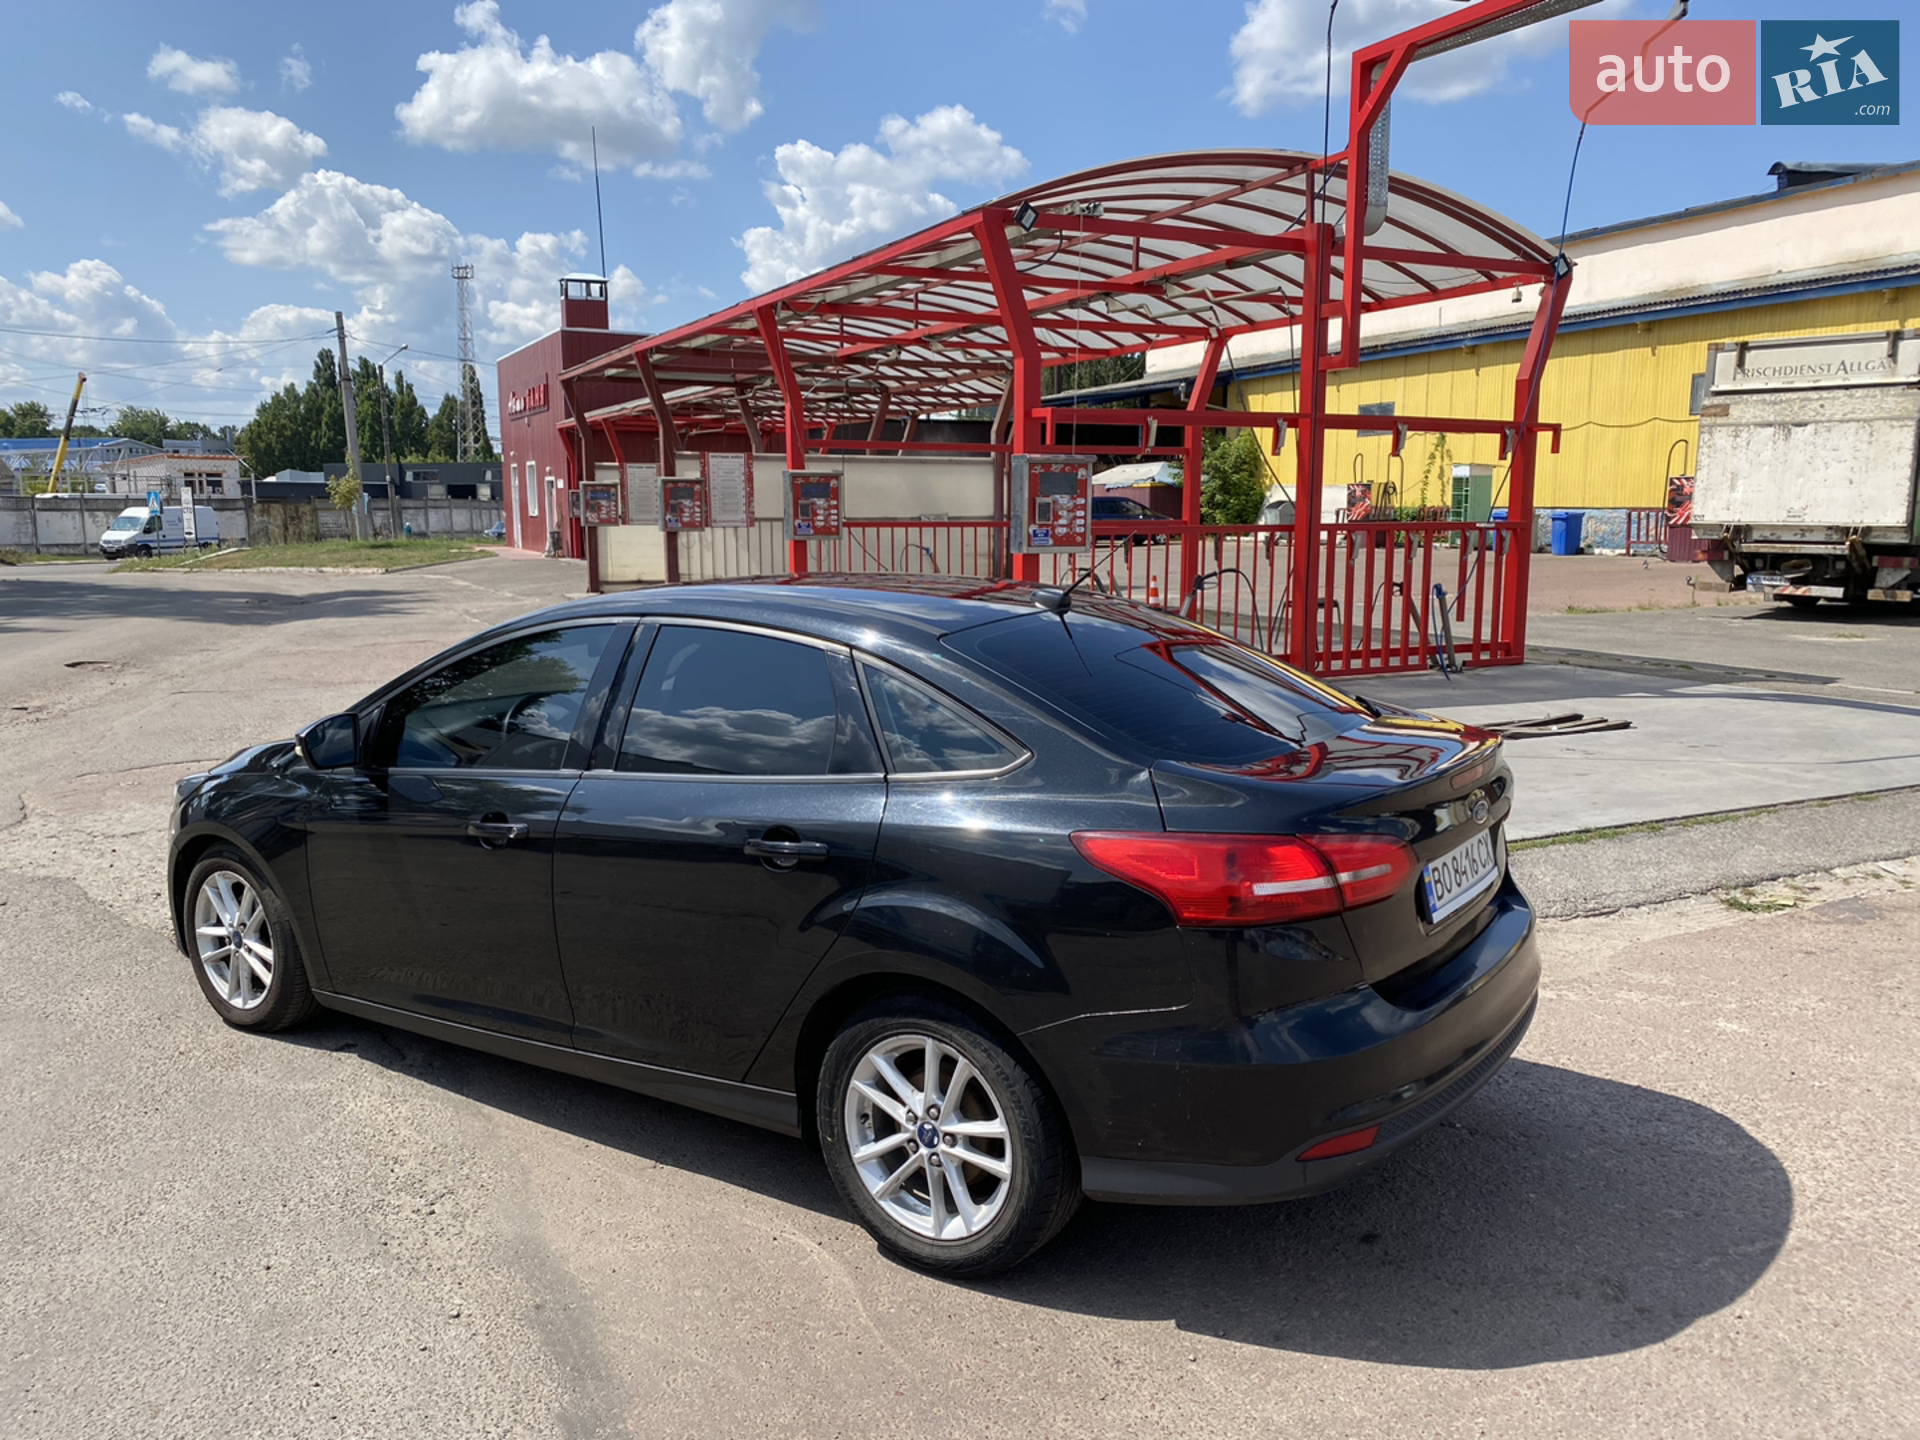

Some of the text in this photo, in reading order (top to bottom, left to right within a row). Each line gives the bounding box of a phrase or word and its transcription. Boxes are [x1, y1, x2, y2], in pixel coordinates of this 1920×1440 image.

[1432, 832, 1495, 902] BO 8416 CX
